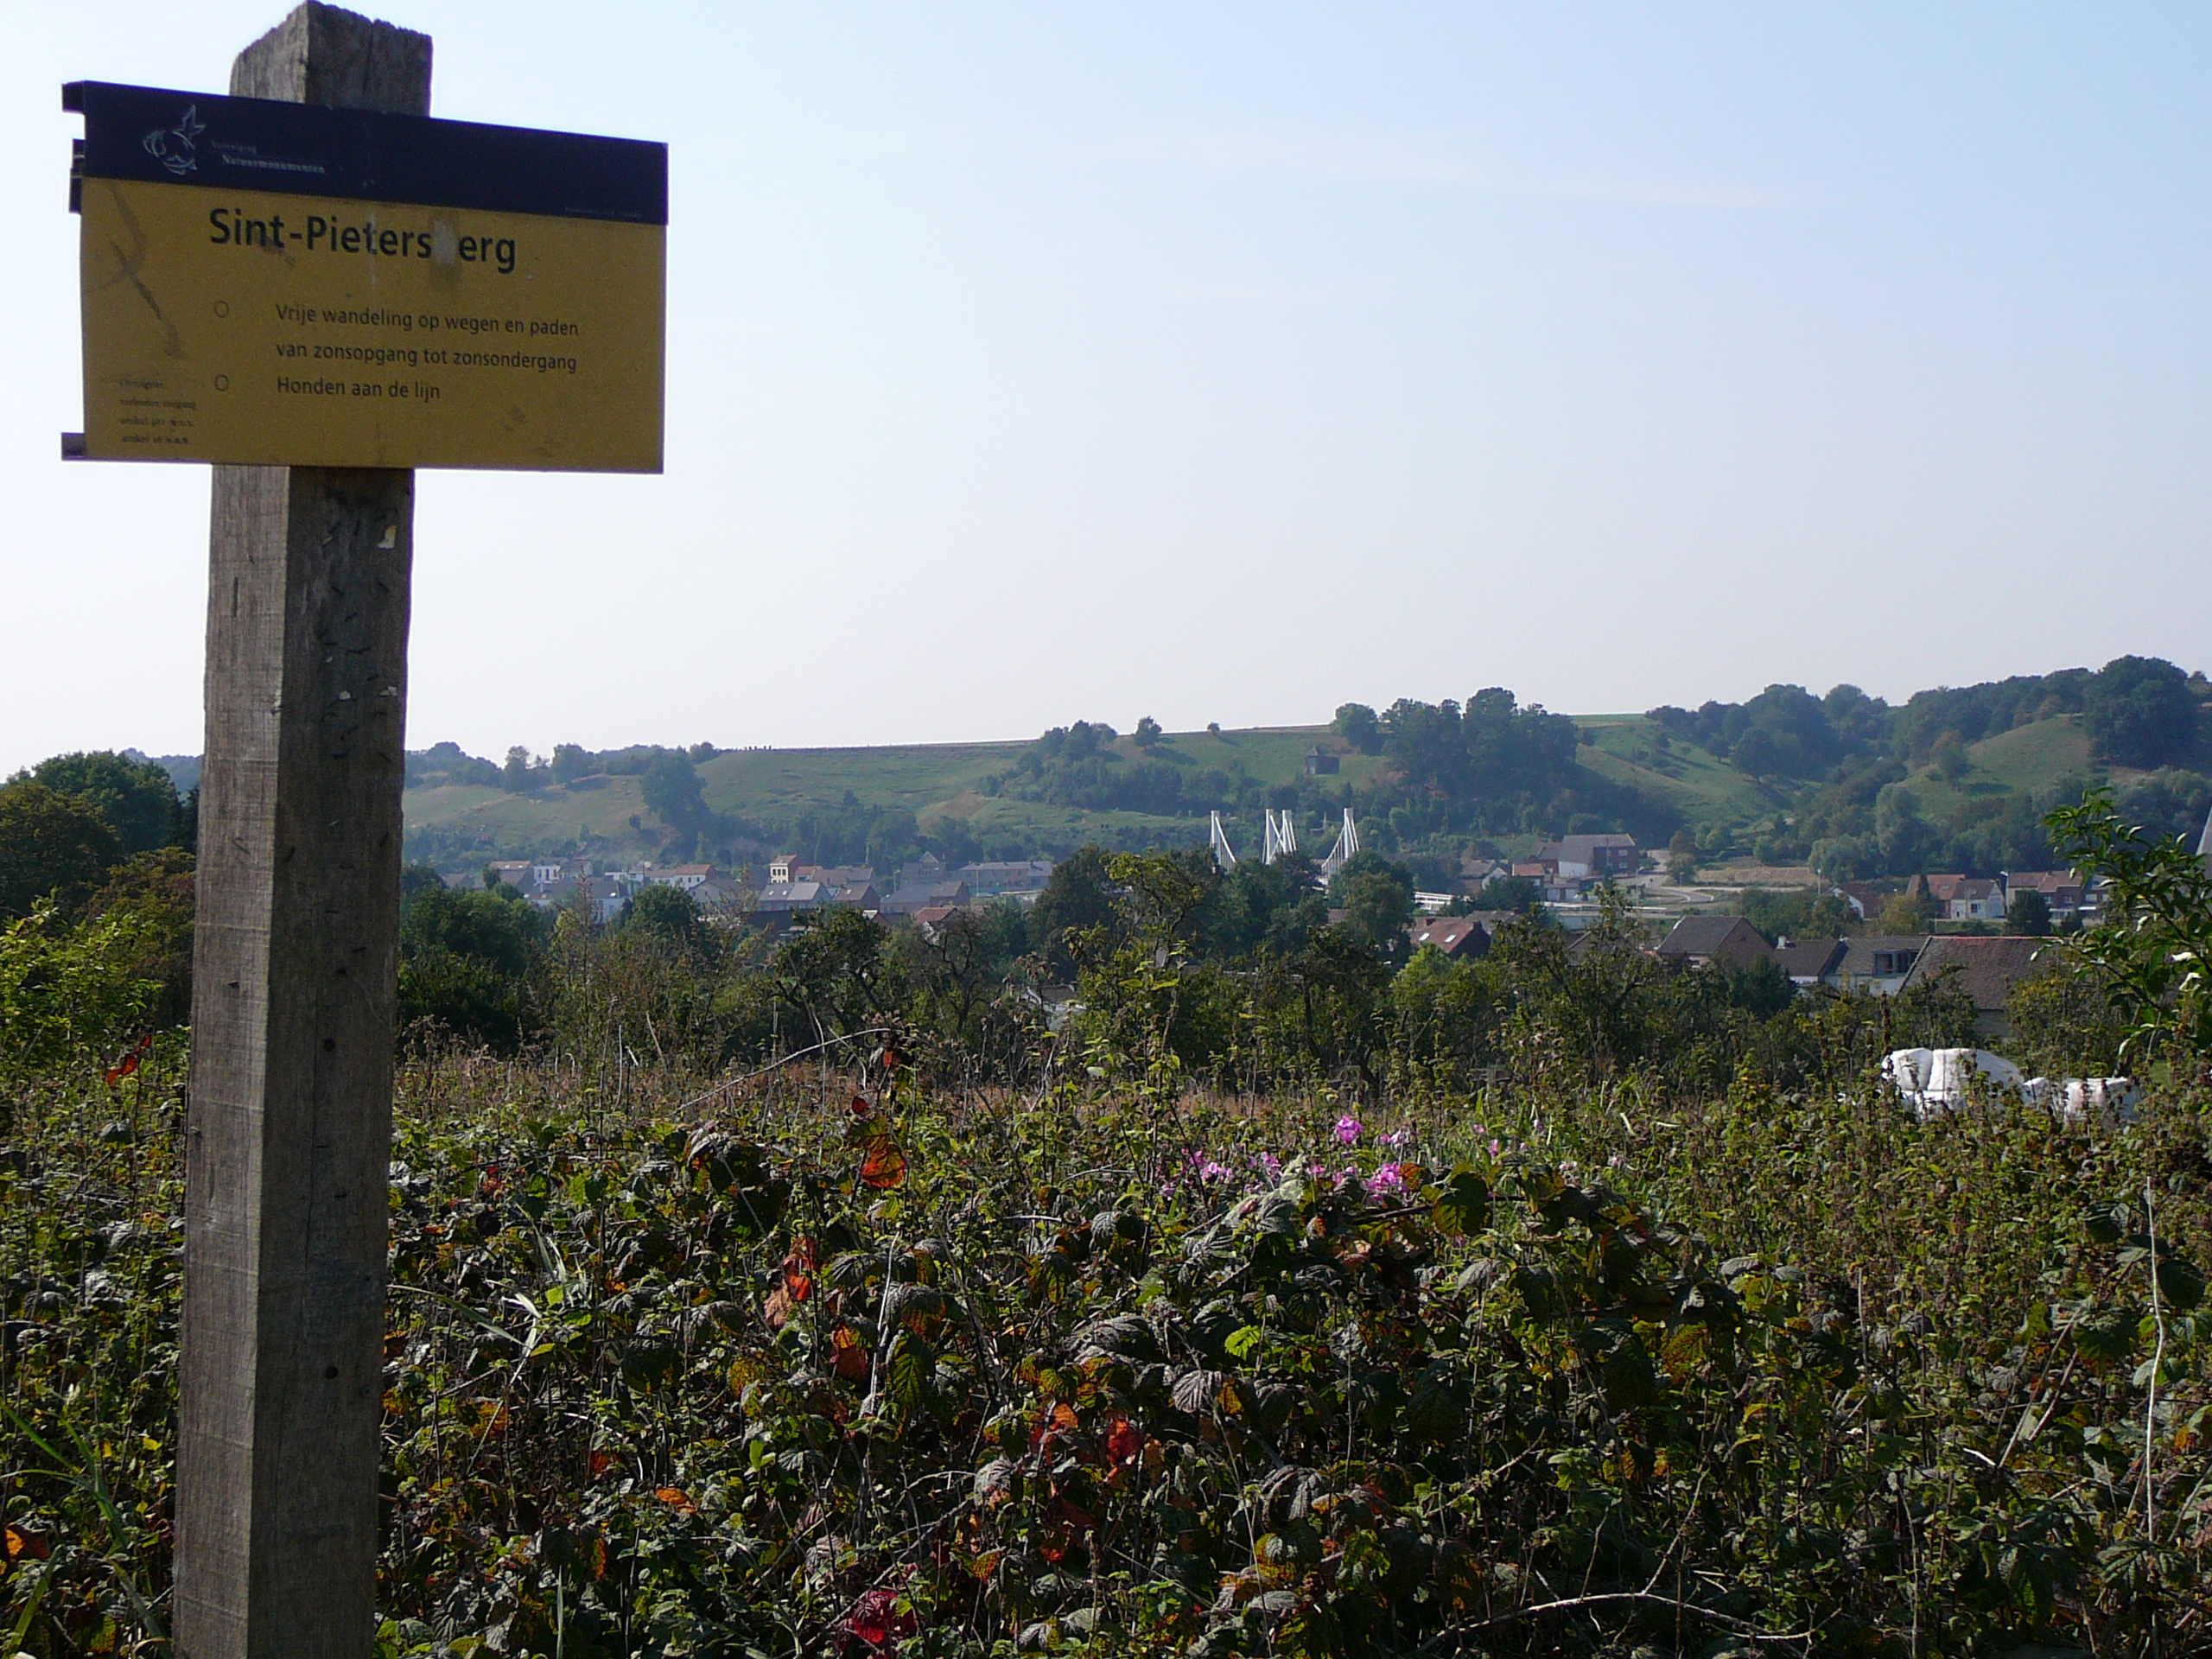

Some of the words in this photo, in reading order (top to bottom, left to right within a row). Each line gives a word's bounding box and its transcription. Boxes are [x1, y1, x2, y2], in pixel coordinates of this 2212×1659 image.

[209, 208, 516, 274] Sint-Pieterserg
[276, 304, 316, 326] Vrije
[322, 307, 412, 331] wandeling
[418, 315, 440, 331] op
[445, 316, 499, 334] wegen
[505, 320, 524, 333] en
[531, 319, 578, 337] paden
[276, 345, 308, 358] van
[314, 345, 417, 367] zonsopgang
[424, 349, 448, 365] tot
[454, 351, 576, 374] zonsondergang
[277, 376, 345, 395] Honden
[352, 383, 382, 397] aan
[388, 381, 409, 397] de
[415, 381, 440, 403] lijn
